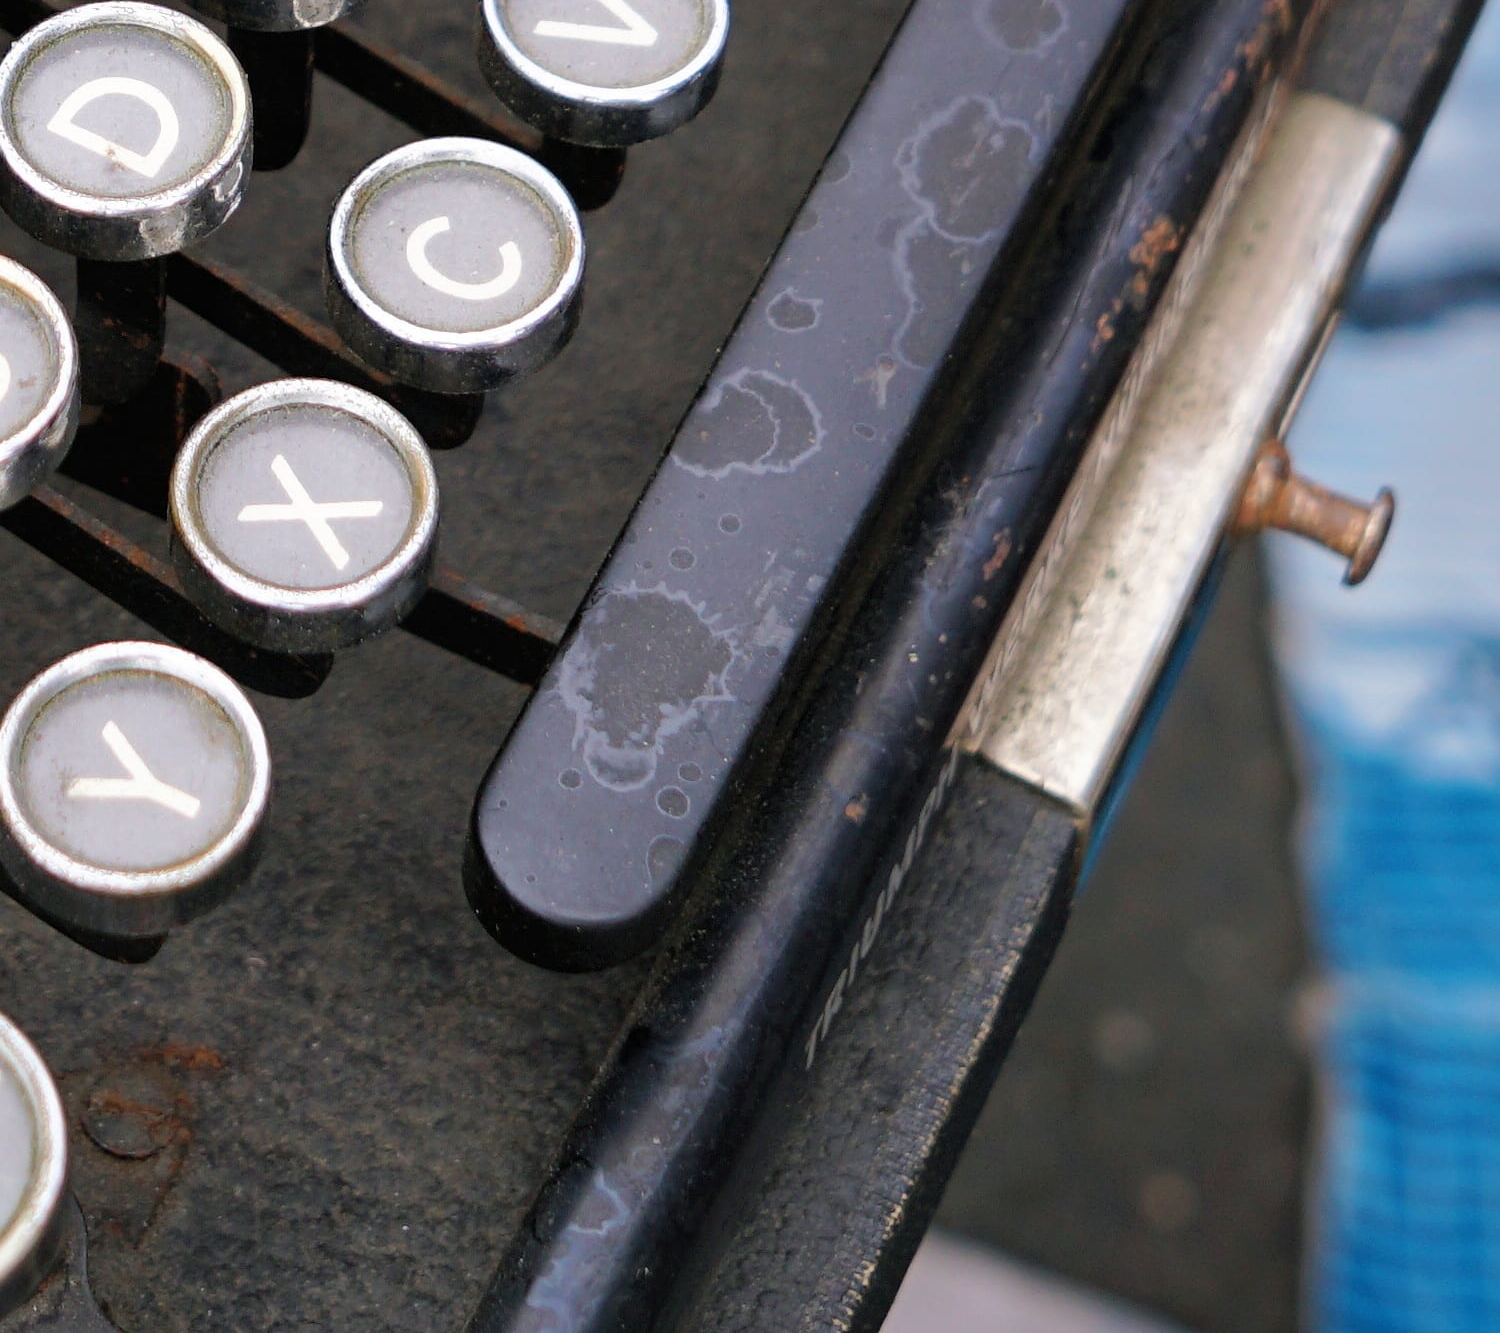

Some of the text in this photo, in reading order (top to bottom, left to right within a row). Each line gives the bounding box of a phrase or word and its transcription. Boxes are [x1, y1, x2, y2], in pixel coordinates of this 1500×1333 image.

[47, 77, 179, 178] D
[406, 216, 522, 300] C
[238, 454, 383, 570] X
[69, 721, 201, 818] Y
